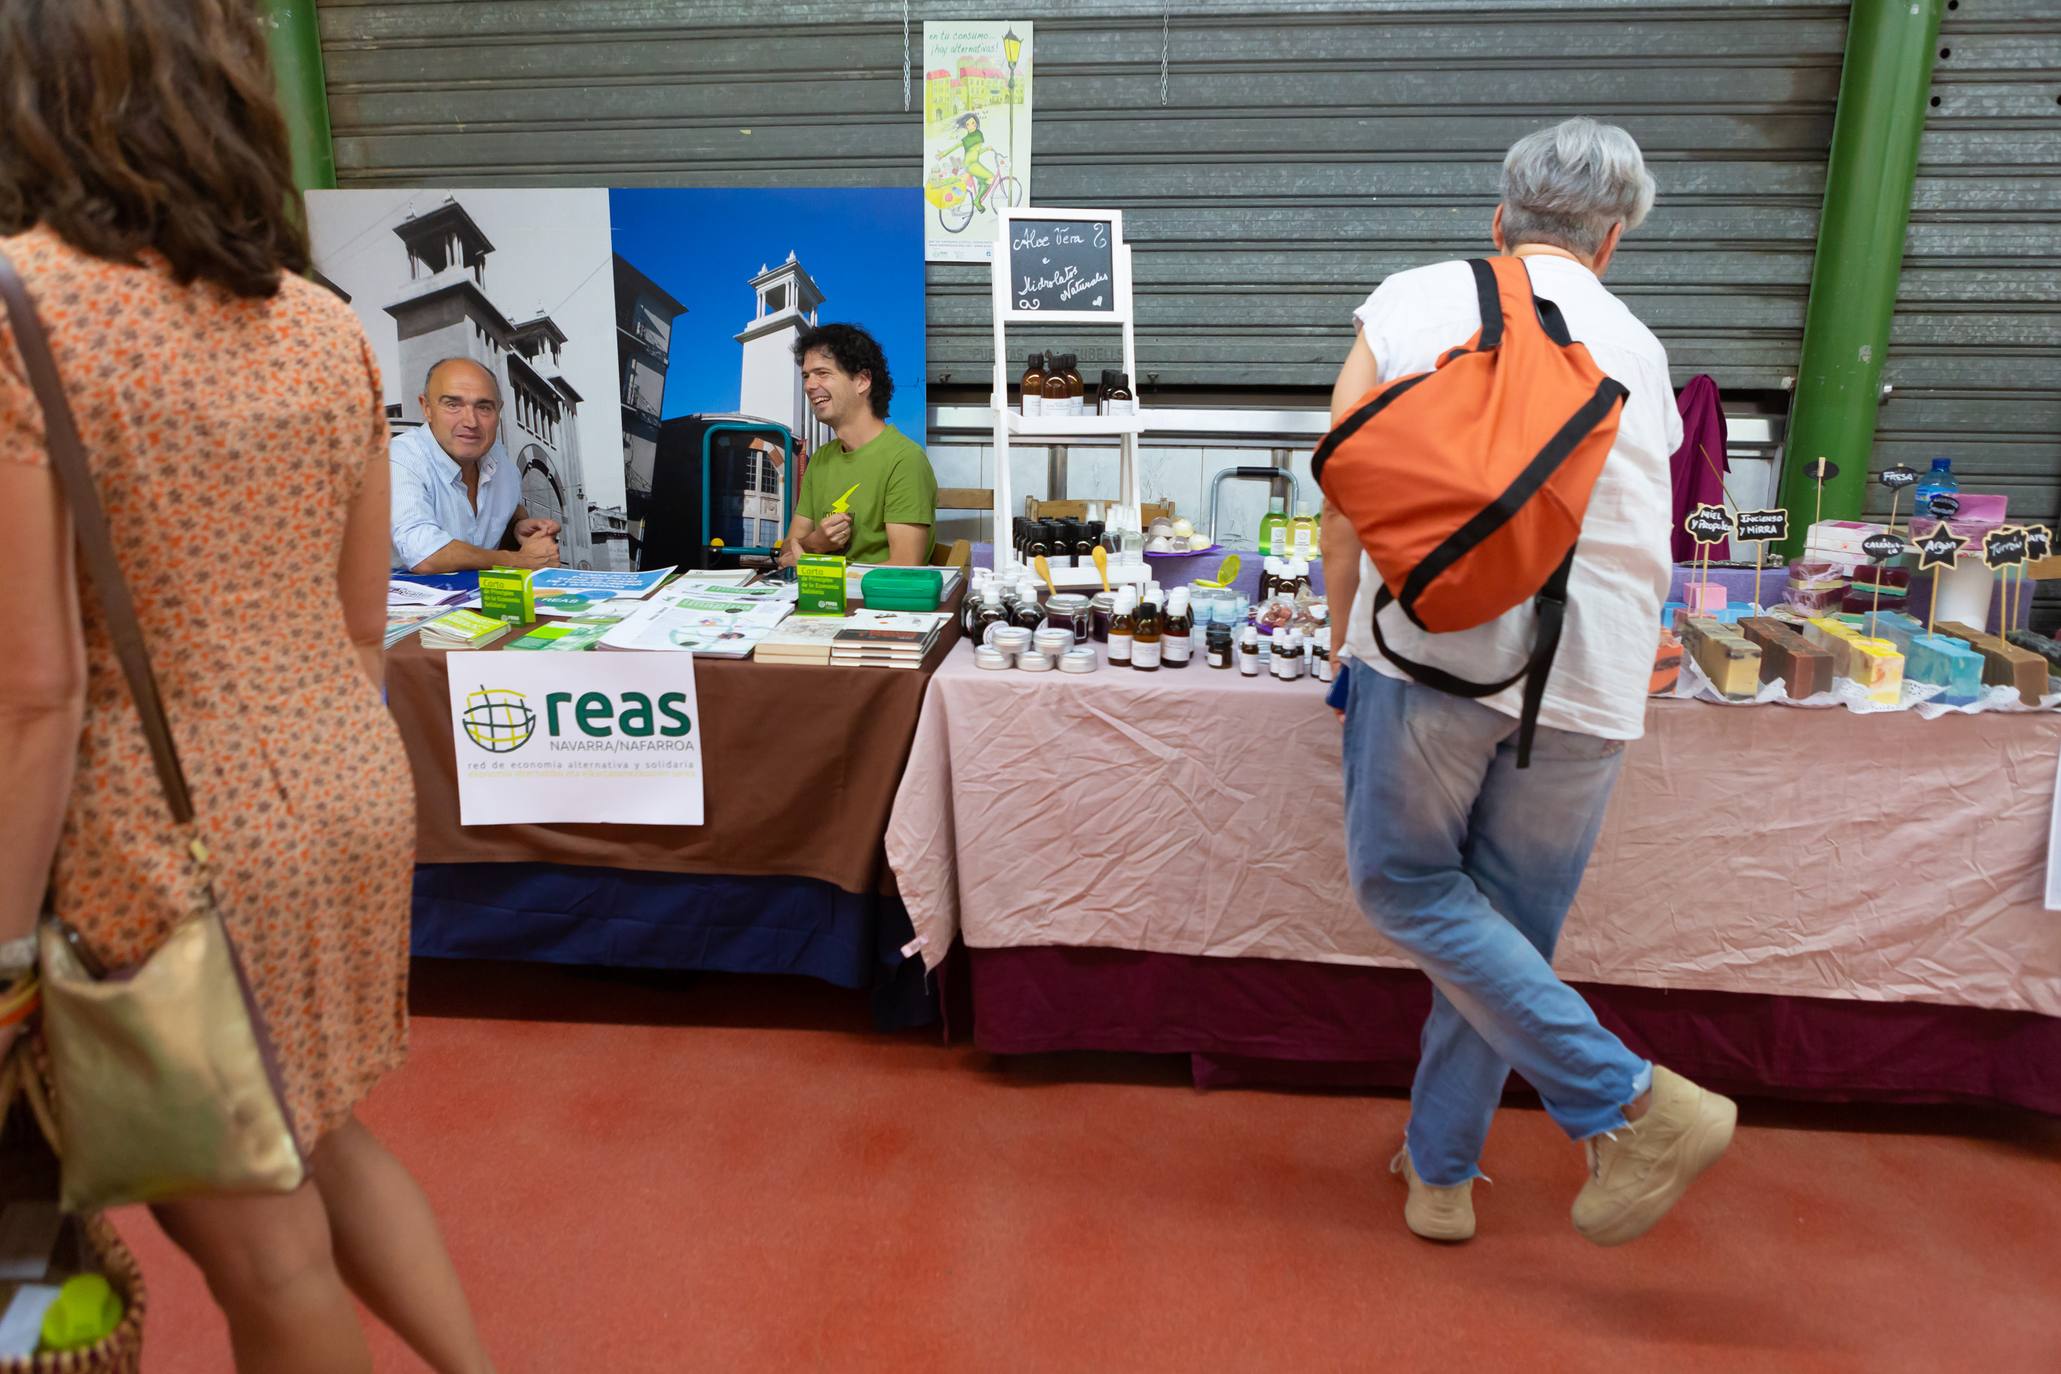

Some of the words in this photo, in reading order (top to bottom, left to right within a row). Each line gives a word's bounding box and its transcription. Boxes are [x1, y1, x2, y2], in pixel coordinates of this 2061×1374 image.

[1013, 227, 1050, 250] Aloe
[1053, 226, 1085, 245] Vera
[1018, 265, 1078, 295] Hidrolatos
[1060, 272, 1108, 302] Naturales
[801, 567, 824, 575] Carta
[546, 691, 692, 737] reas
[549, 740, 695, 753] NAVARRA/NAFARROA
[467, 760, 486, 769] red
[492, 760, 505, 769] de
[567, 760, 629, 769] alternativa
[645, 760, 695, 769] solidaria
